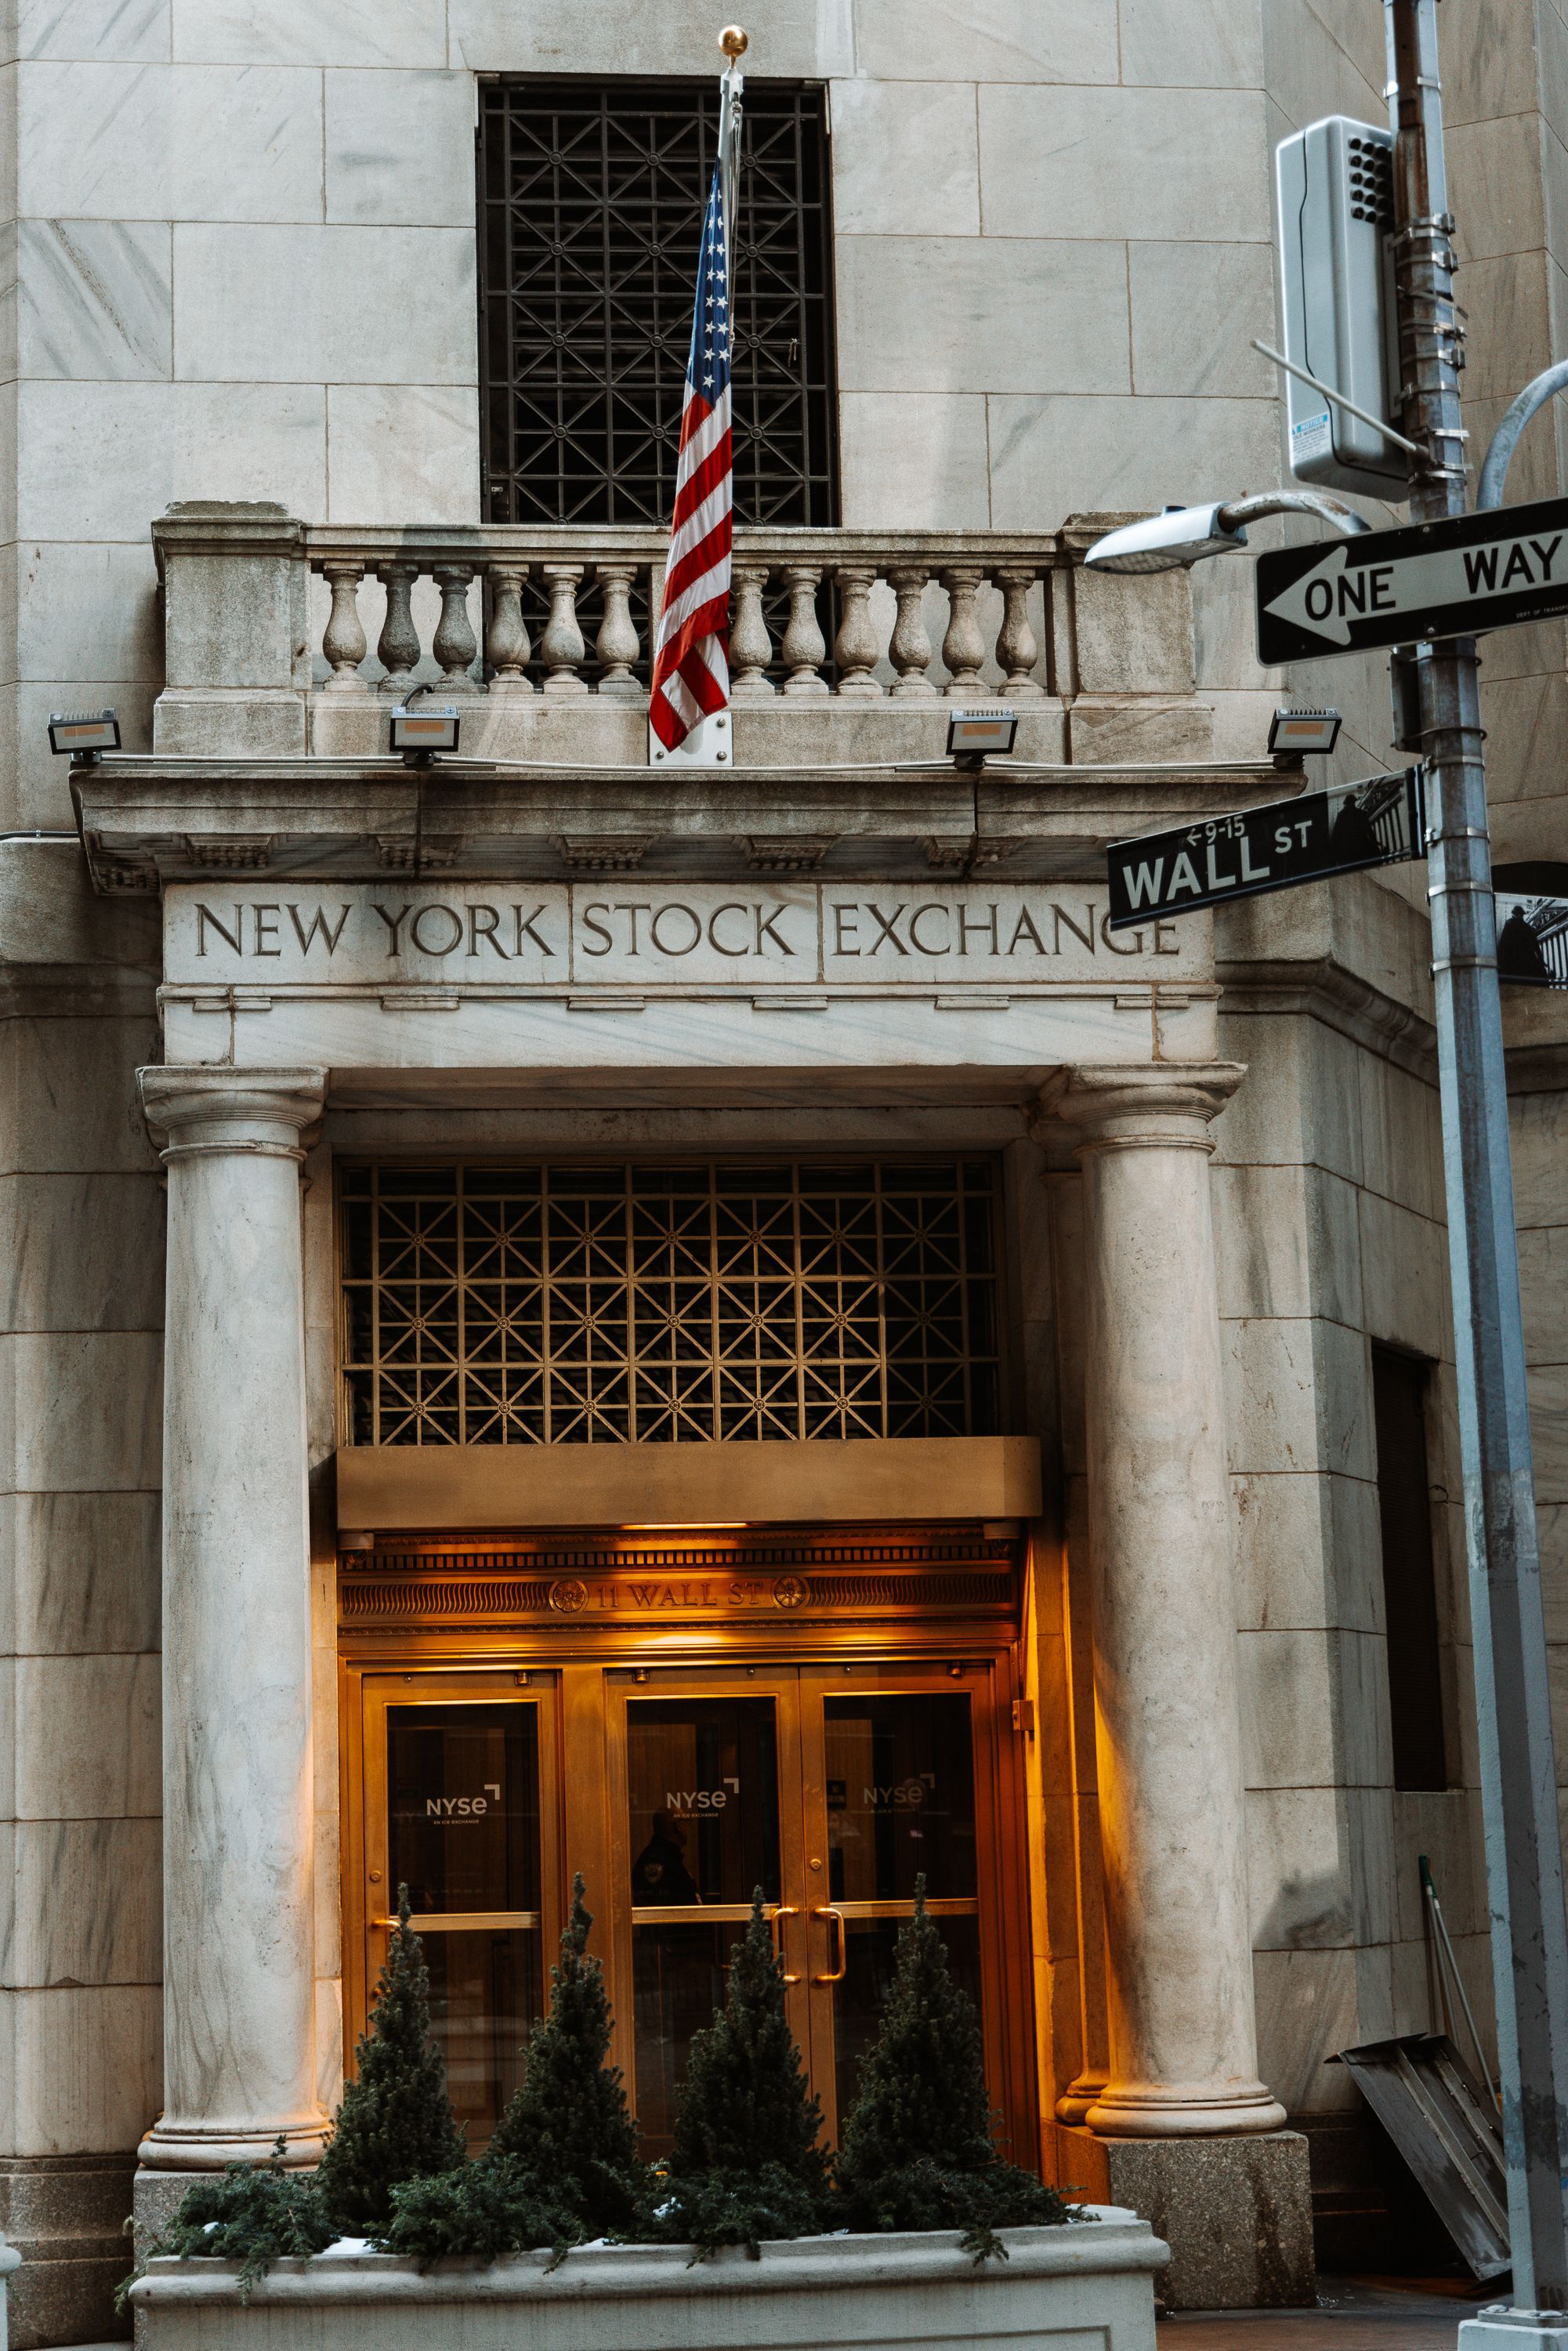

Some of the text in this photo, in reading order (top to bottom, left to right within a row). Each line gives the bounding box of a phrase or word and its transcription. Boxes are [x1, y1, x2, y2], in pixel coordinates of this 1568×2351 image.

[1305, 535, 1563, 621] ONE WAY
[1205, 815, 1245, 844] 9-15
[1122, 820, 1313, 909] WALL ST
[194, 902, 1181, 962] NEW YORK STOCK EXCHANGE
[598, 1581, 763, 1607] 11 WALL ST
